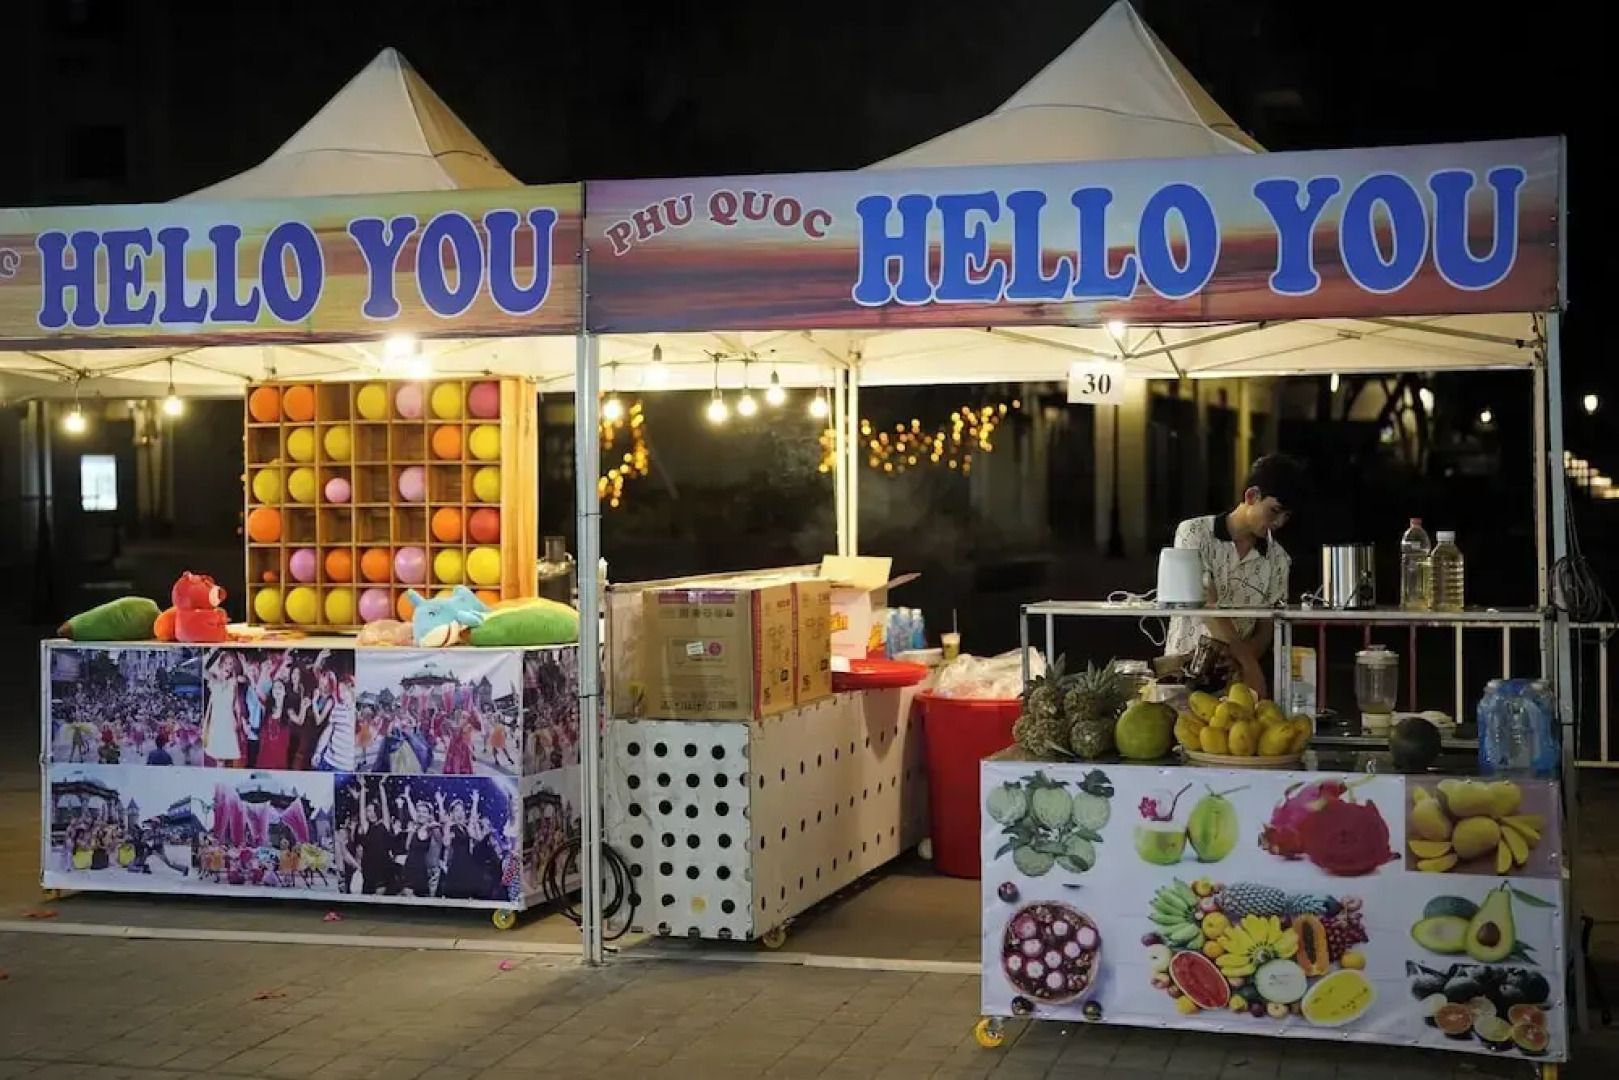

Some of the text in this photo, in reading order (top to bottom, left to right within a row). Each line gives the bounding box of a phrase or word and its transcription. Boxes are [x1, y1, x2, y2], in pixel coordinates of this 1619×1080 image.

[37, 208, 558, 329] HELLO YOU
[605, 167, 1527, 306] PHU QUOC HELLO YOU
[1081, 373, 1112, 395] 30
